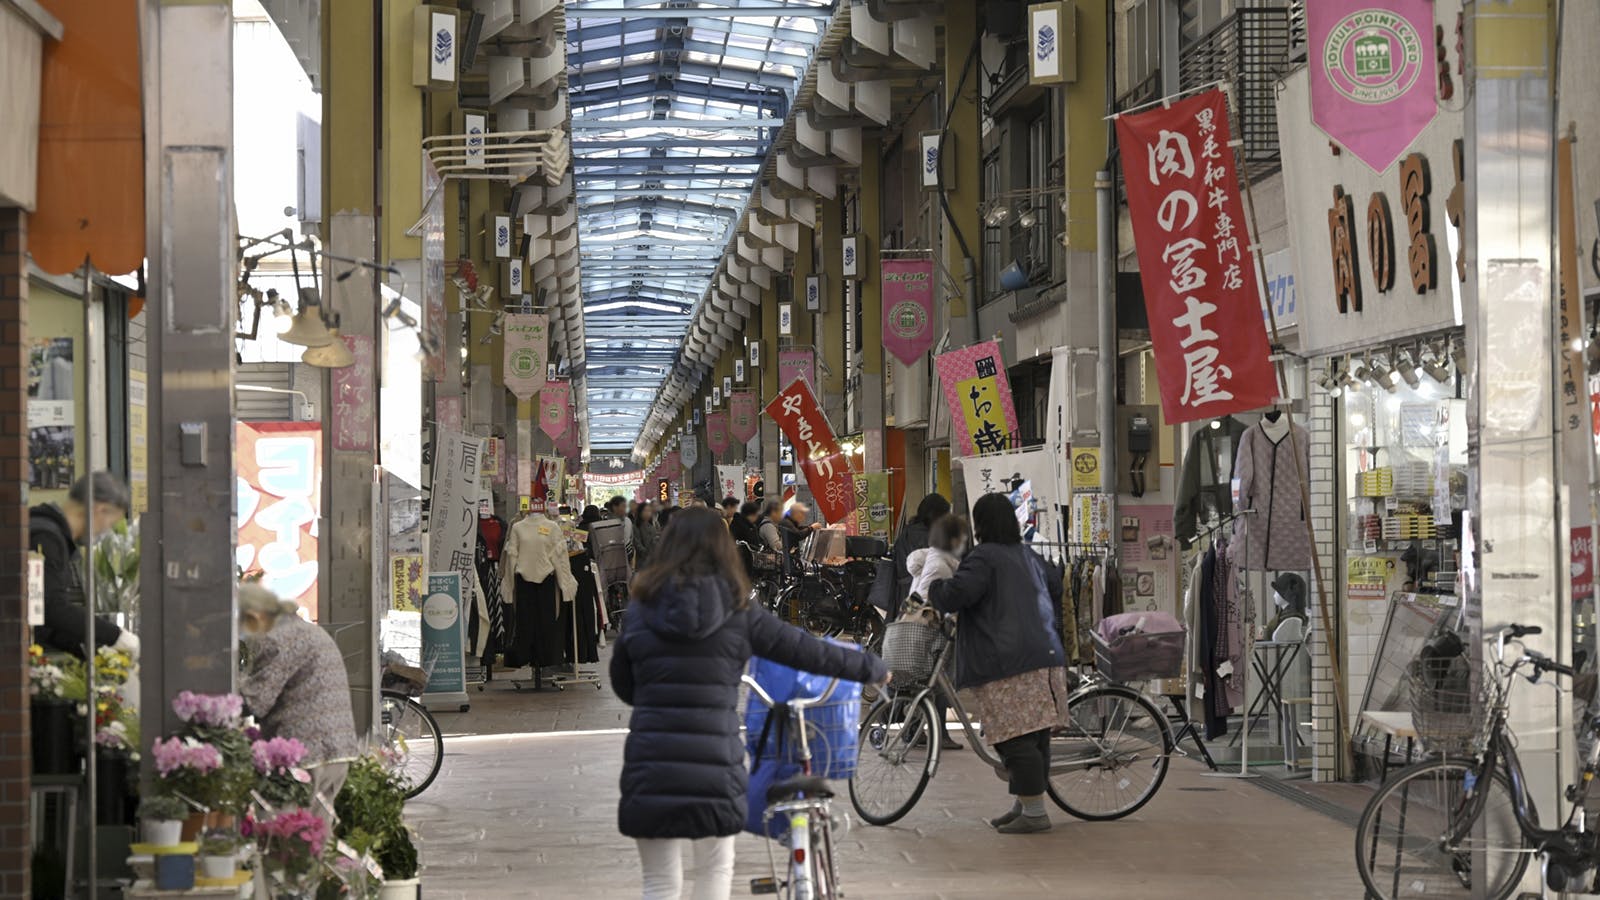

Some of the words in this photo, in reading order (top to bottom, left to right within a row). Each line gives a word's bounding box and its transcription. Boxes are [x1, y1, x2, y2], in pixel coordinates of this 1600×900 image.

[1328, 25, 1352, 67] JOYFUL
[1355, 13, 1397, 27] POINT
[1398, 26, 1418, 62] CARD
[1354, 87, 1377, 99] SINCE
[1194, 108, 1243, 290] 黒毛和牛専門店
[781, 394, 834, 480] やきとり
[530, 503, 545, 511] SALE
[428, 577, 455, 585] みほぐし
